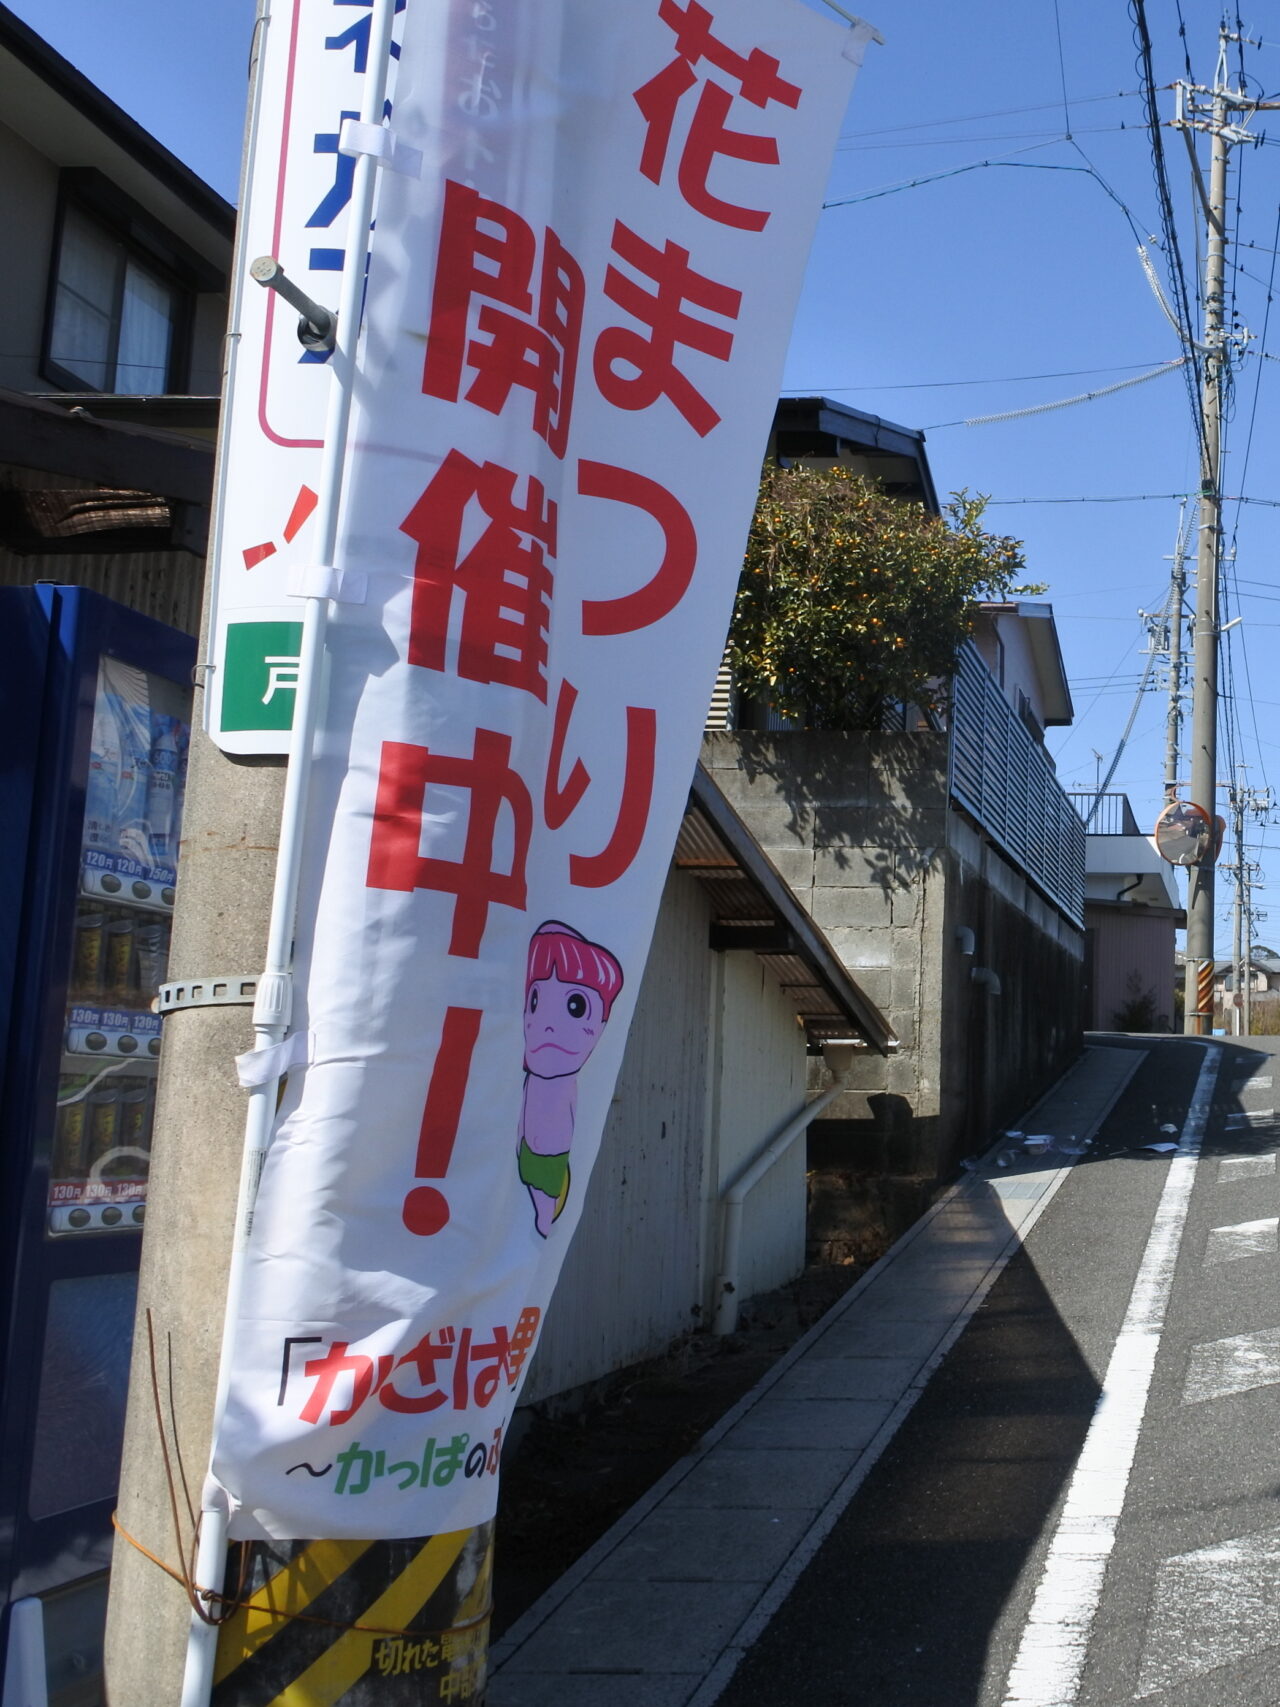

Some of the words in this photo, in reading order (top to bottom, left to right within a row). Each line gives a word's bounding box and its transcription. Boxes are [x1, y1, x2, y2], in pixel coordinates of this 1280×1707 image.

[544, 0, 803, 888] 花まつり
[86, 851, 114, 869] 120円
[116, 858, 142, 875] 120円
[71, 1009, 99, 1024] 130円
[102, 1012, 129, 1026] 130円
[134, 1016, 159, 1029] 130円
[53, 1186, 81, 1199] 130円
